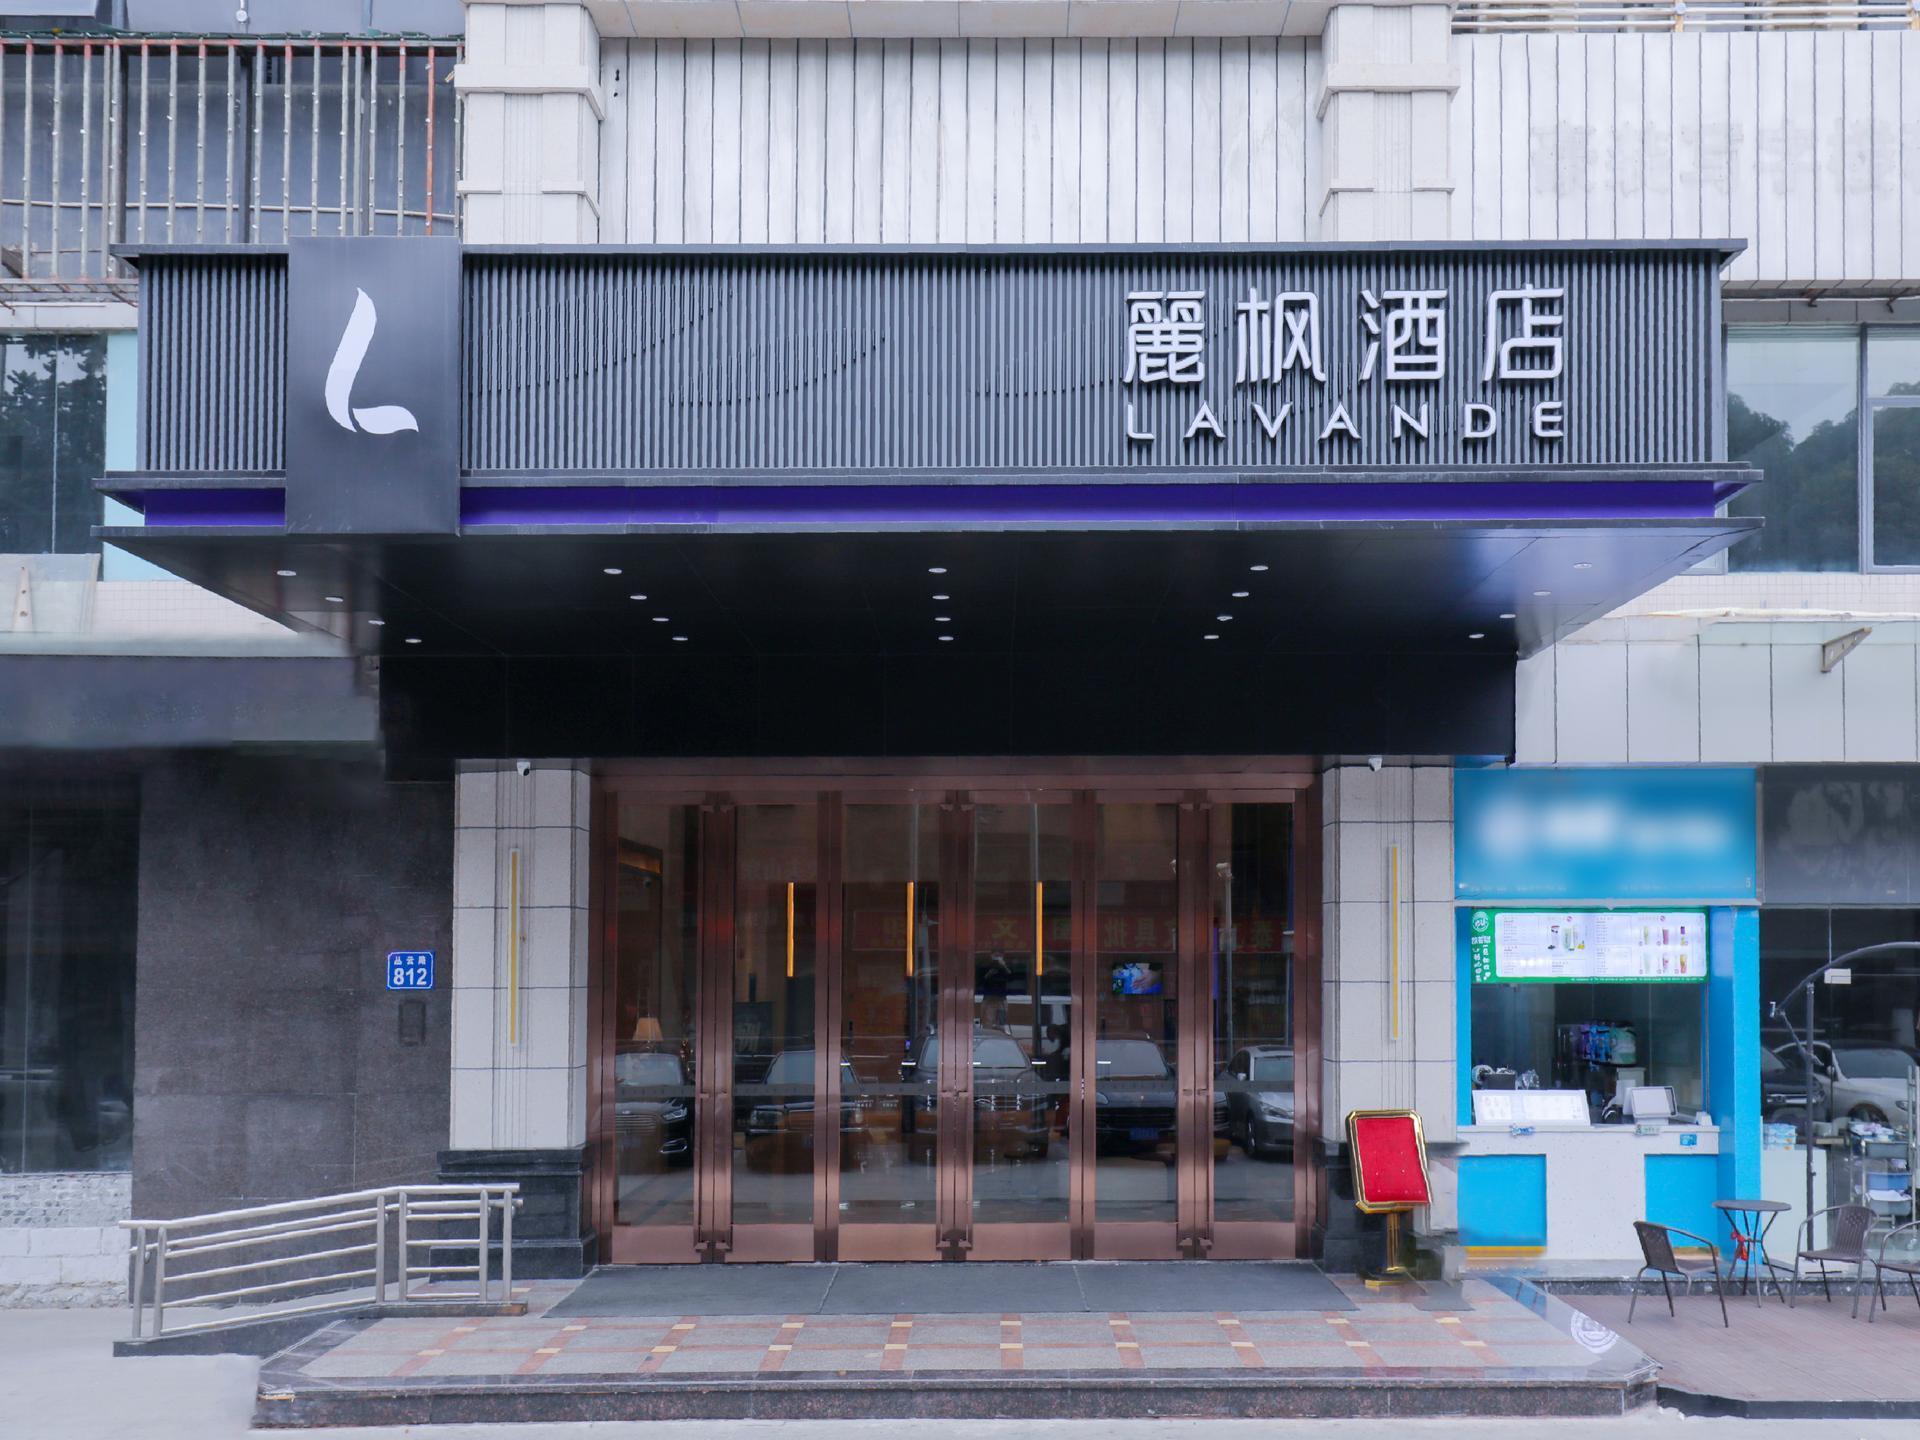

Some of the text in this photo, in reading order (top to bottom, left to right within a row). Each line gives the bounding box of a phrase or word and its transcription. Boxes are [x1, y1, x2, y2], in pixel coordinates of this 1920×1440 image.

[1123, 284, 1565, 384] 麗枫酒店
[1126, 401, 1565, 440] LAVANDE
[393, 967, 427, 986] 812
